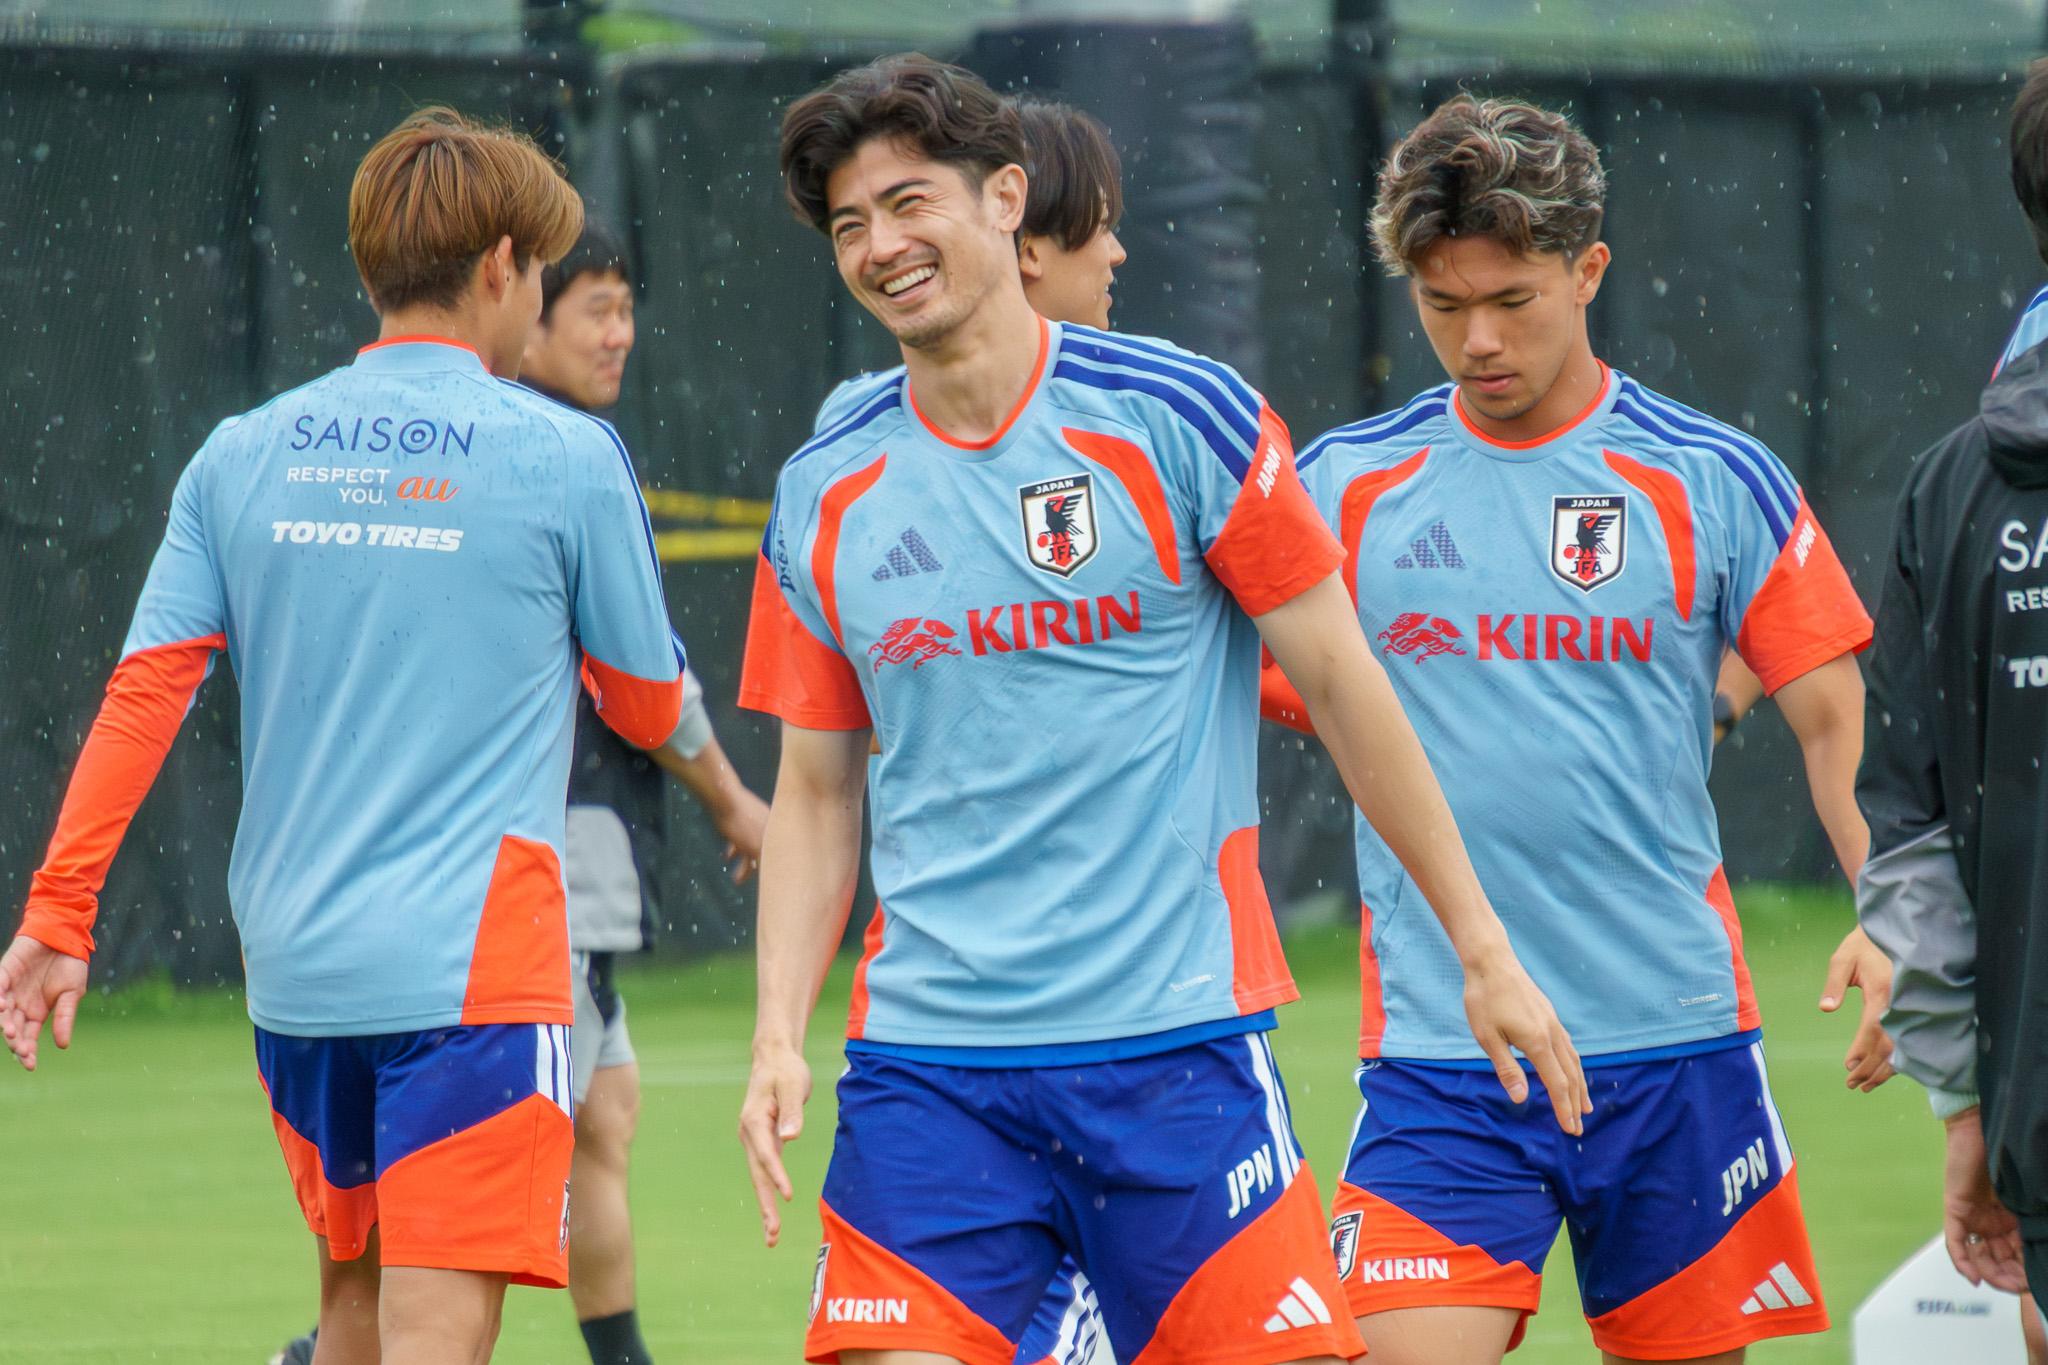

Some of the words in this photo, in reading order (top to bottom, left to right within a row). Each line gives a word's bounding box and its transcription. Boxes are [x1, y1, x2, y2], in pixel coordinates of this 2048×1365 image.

[290, 415, 475, 457] SAISON
[287, 467, 390, 484] RESPECT
[1256, 442, 1281, 498] JAPAN
[339, 488, 388, 507] YOU,
[397, 476, 460, 502] au
[1034, 479, 1074, 494] JAPAN
[1571, 499, 1610, 508] JAPAN
[272, 521, 361, 545] TOYO
[366, 524, 464, 552] TIRES
[1794, 519, 1817, 568] JAPAN
[1047, 543, 1079, 562] JFA
[1570, 561, 1603, 574] JFA
[966, 590, 1142, 656] KIRIN
[1476, 614, 1654, 663] KIRIN
[1227, 1143, 1273, 1219] JPN
[1722, 1137, 1769, 1216] JPN
[1363, 1257, 1450, 1284] KIRIN
[828, 1297, 908, 1323] KIRIN
